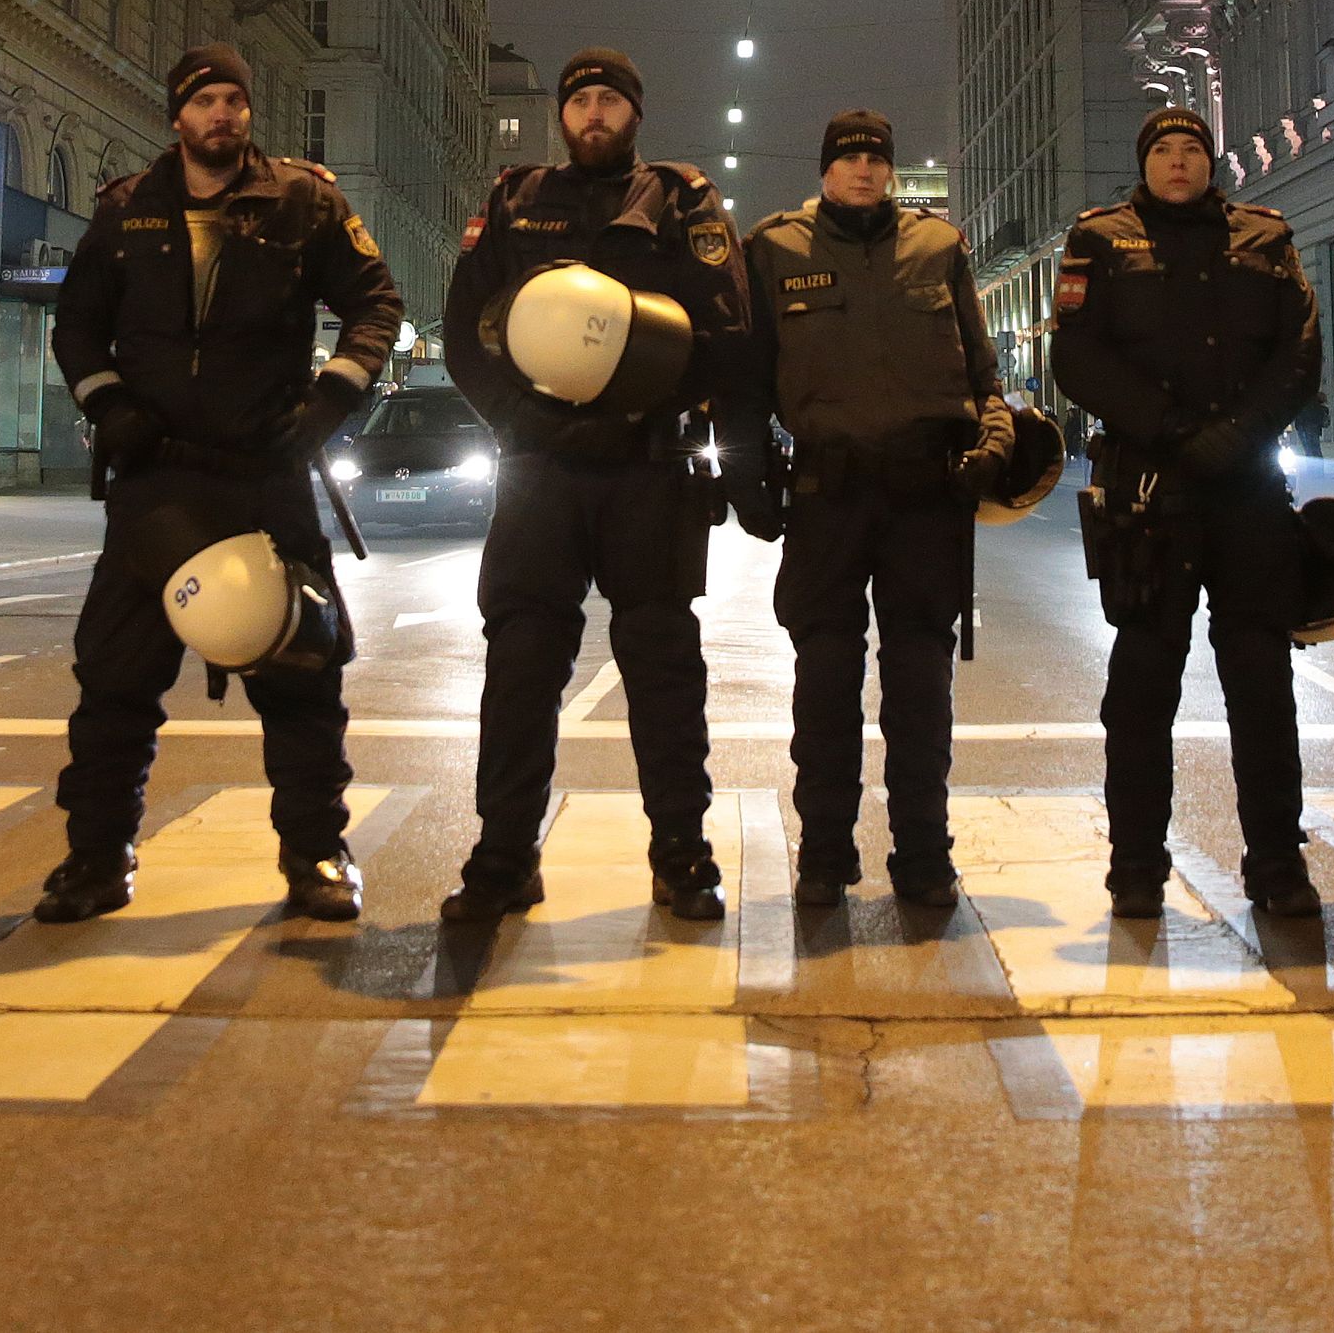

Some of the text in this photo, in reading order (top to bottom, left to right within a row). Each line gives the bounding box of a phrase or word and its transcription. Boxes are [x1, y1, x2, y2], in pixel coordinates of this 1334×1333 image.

[13, 268, 51, 278] KAUKAS
[784, 273, 832, 291] POLIZEI
[582, 315, 608, 347] 12
[175, 576, 201, 609] 90
